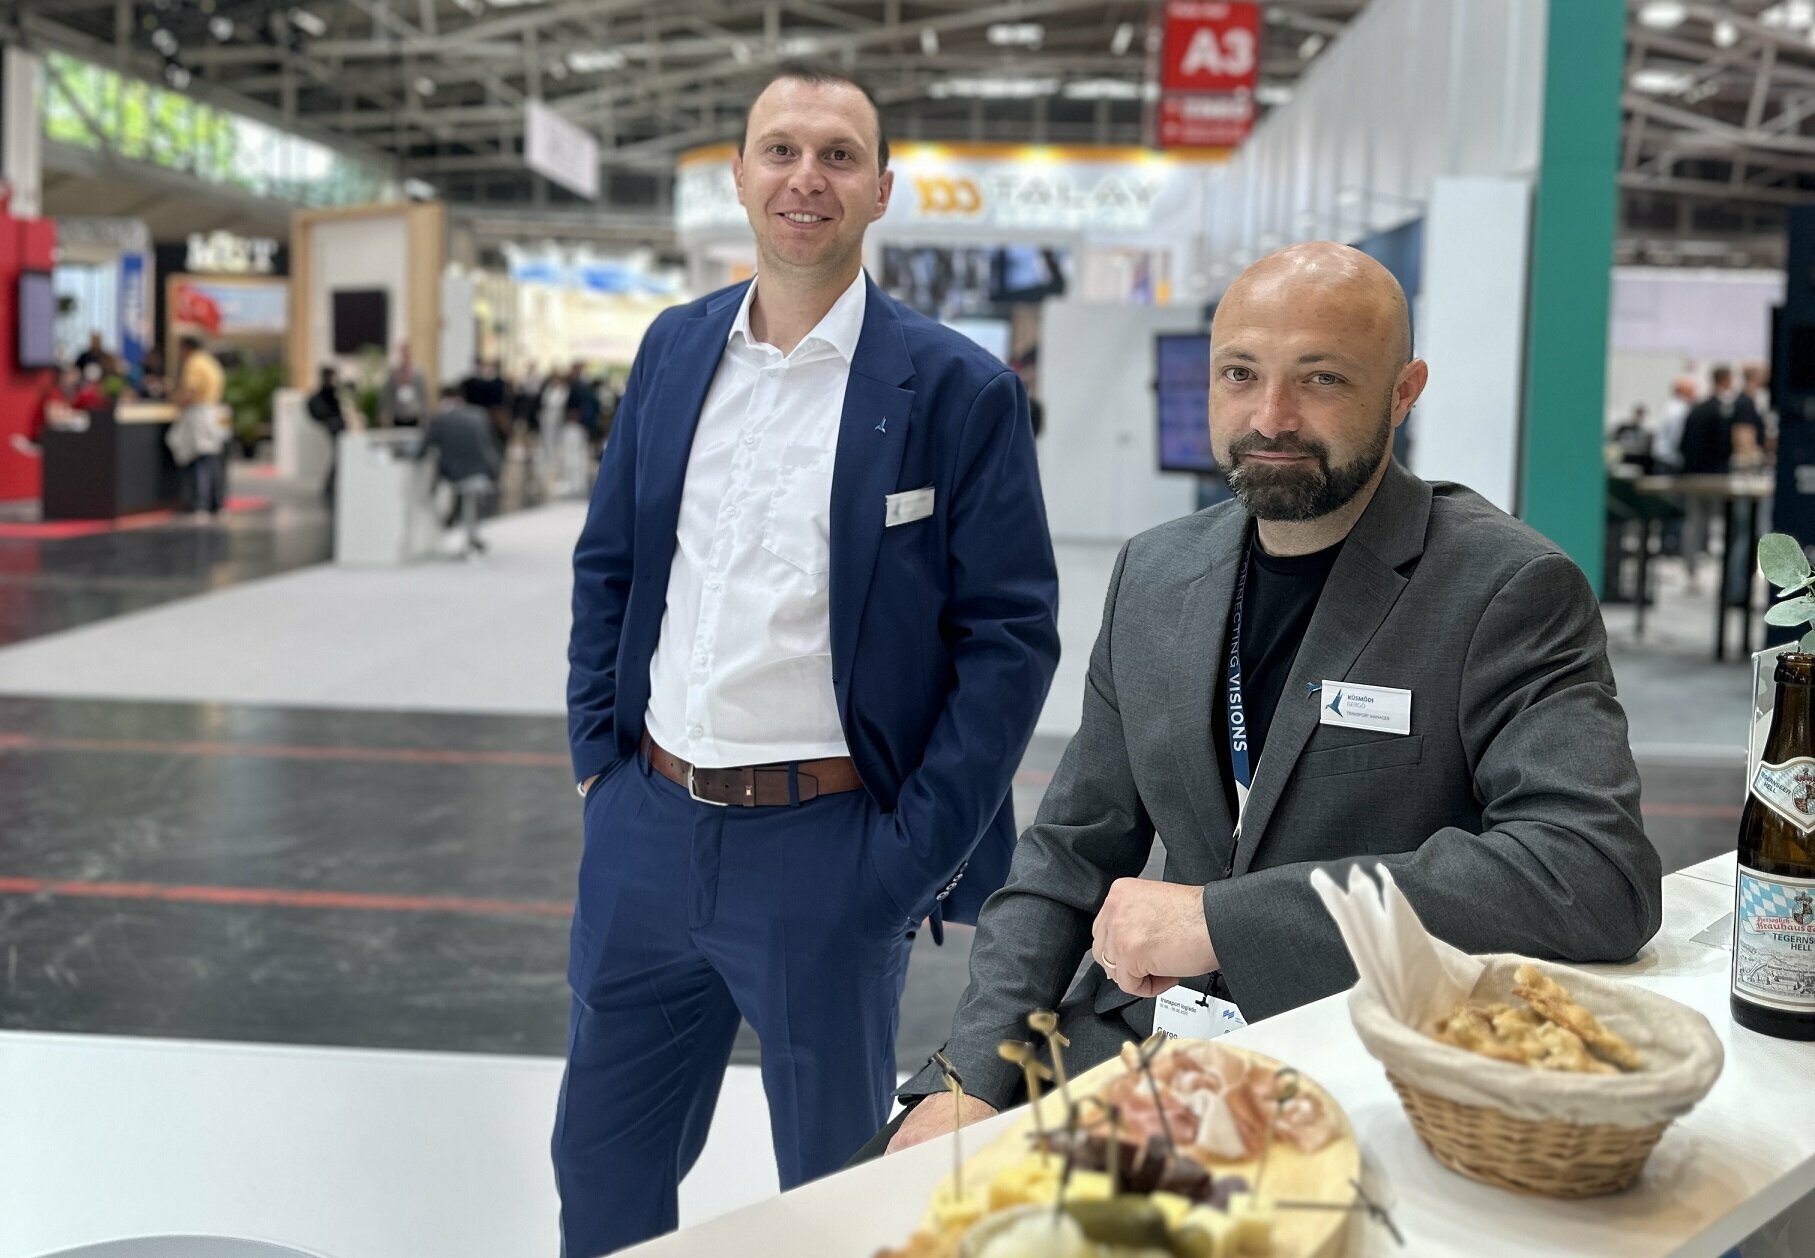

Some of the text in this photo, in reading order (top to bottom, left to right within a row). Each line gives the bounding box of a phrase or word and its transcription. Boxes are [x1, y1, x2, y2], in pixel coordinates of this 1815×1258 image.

[1180, 27, 1255, 77] A3
[1229, 552, 1248, 752] CONNECTING VISIONS
[1756, 923, 1806, 931] Brauhaus
[1772, 932, 1815, 944] TEGERNS
[1790, 944, 1813, 952] HELL
